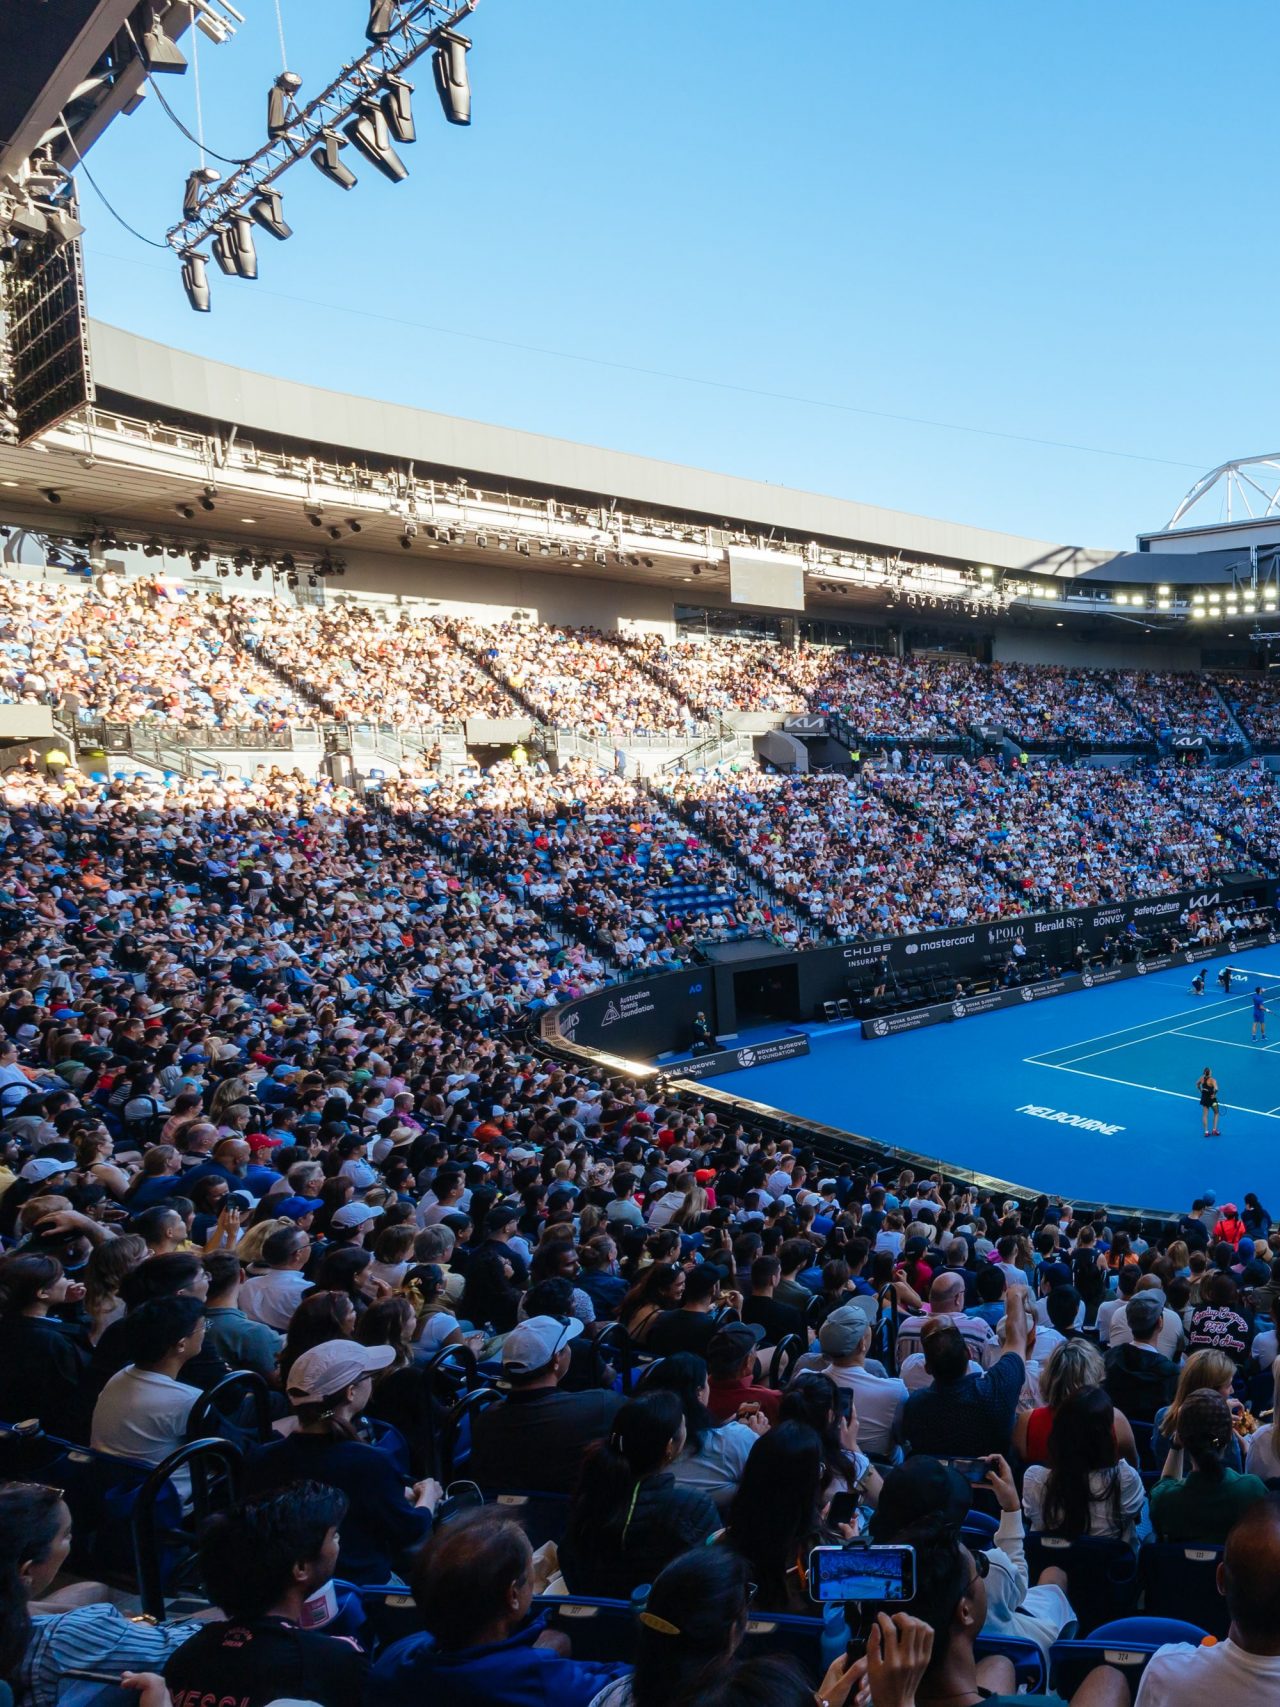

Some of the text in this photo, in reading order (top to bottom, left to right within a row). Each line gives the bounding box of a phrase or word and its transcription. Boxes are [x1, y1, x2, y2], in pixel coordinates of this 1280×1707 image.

[1189, 893, 1220, 909] KIA
[1134, 902, 1180, 916] SafetyCulture
[1035, 919, 1064, 933] Herald
[1093, 914, 1126, 927] BONVOY
[996, 926, 1025, 939] POLO
[920, 933, 975, 951] mastercard
[843, 943, 892, 958] CHUBB
[689, 984, 703, 995] AO
[620, 991, 650, 1004] Australian
[620, 1002, 638, 1011] Tennis
[621, 1004, 654, 1019] Foundation
[890, 1020, 920, 1030] FOUNDATION
[757, 1039, 808, 1055] NOVAK DJOKOVIC
[758, 1048, 795, 1061] FOUNDATION
[684, 1060, 716, 1073] DJOKOVIC
[1014, 1104, 1127, 1136] MELBOURNE
